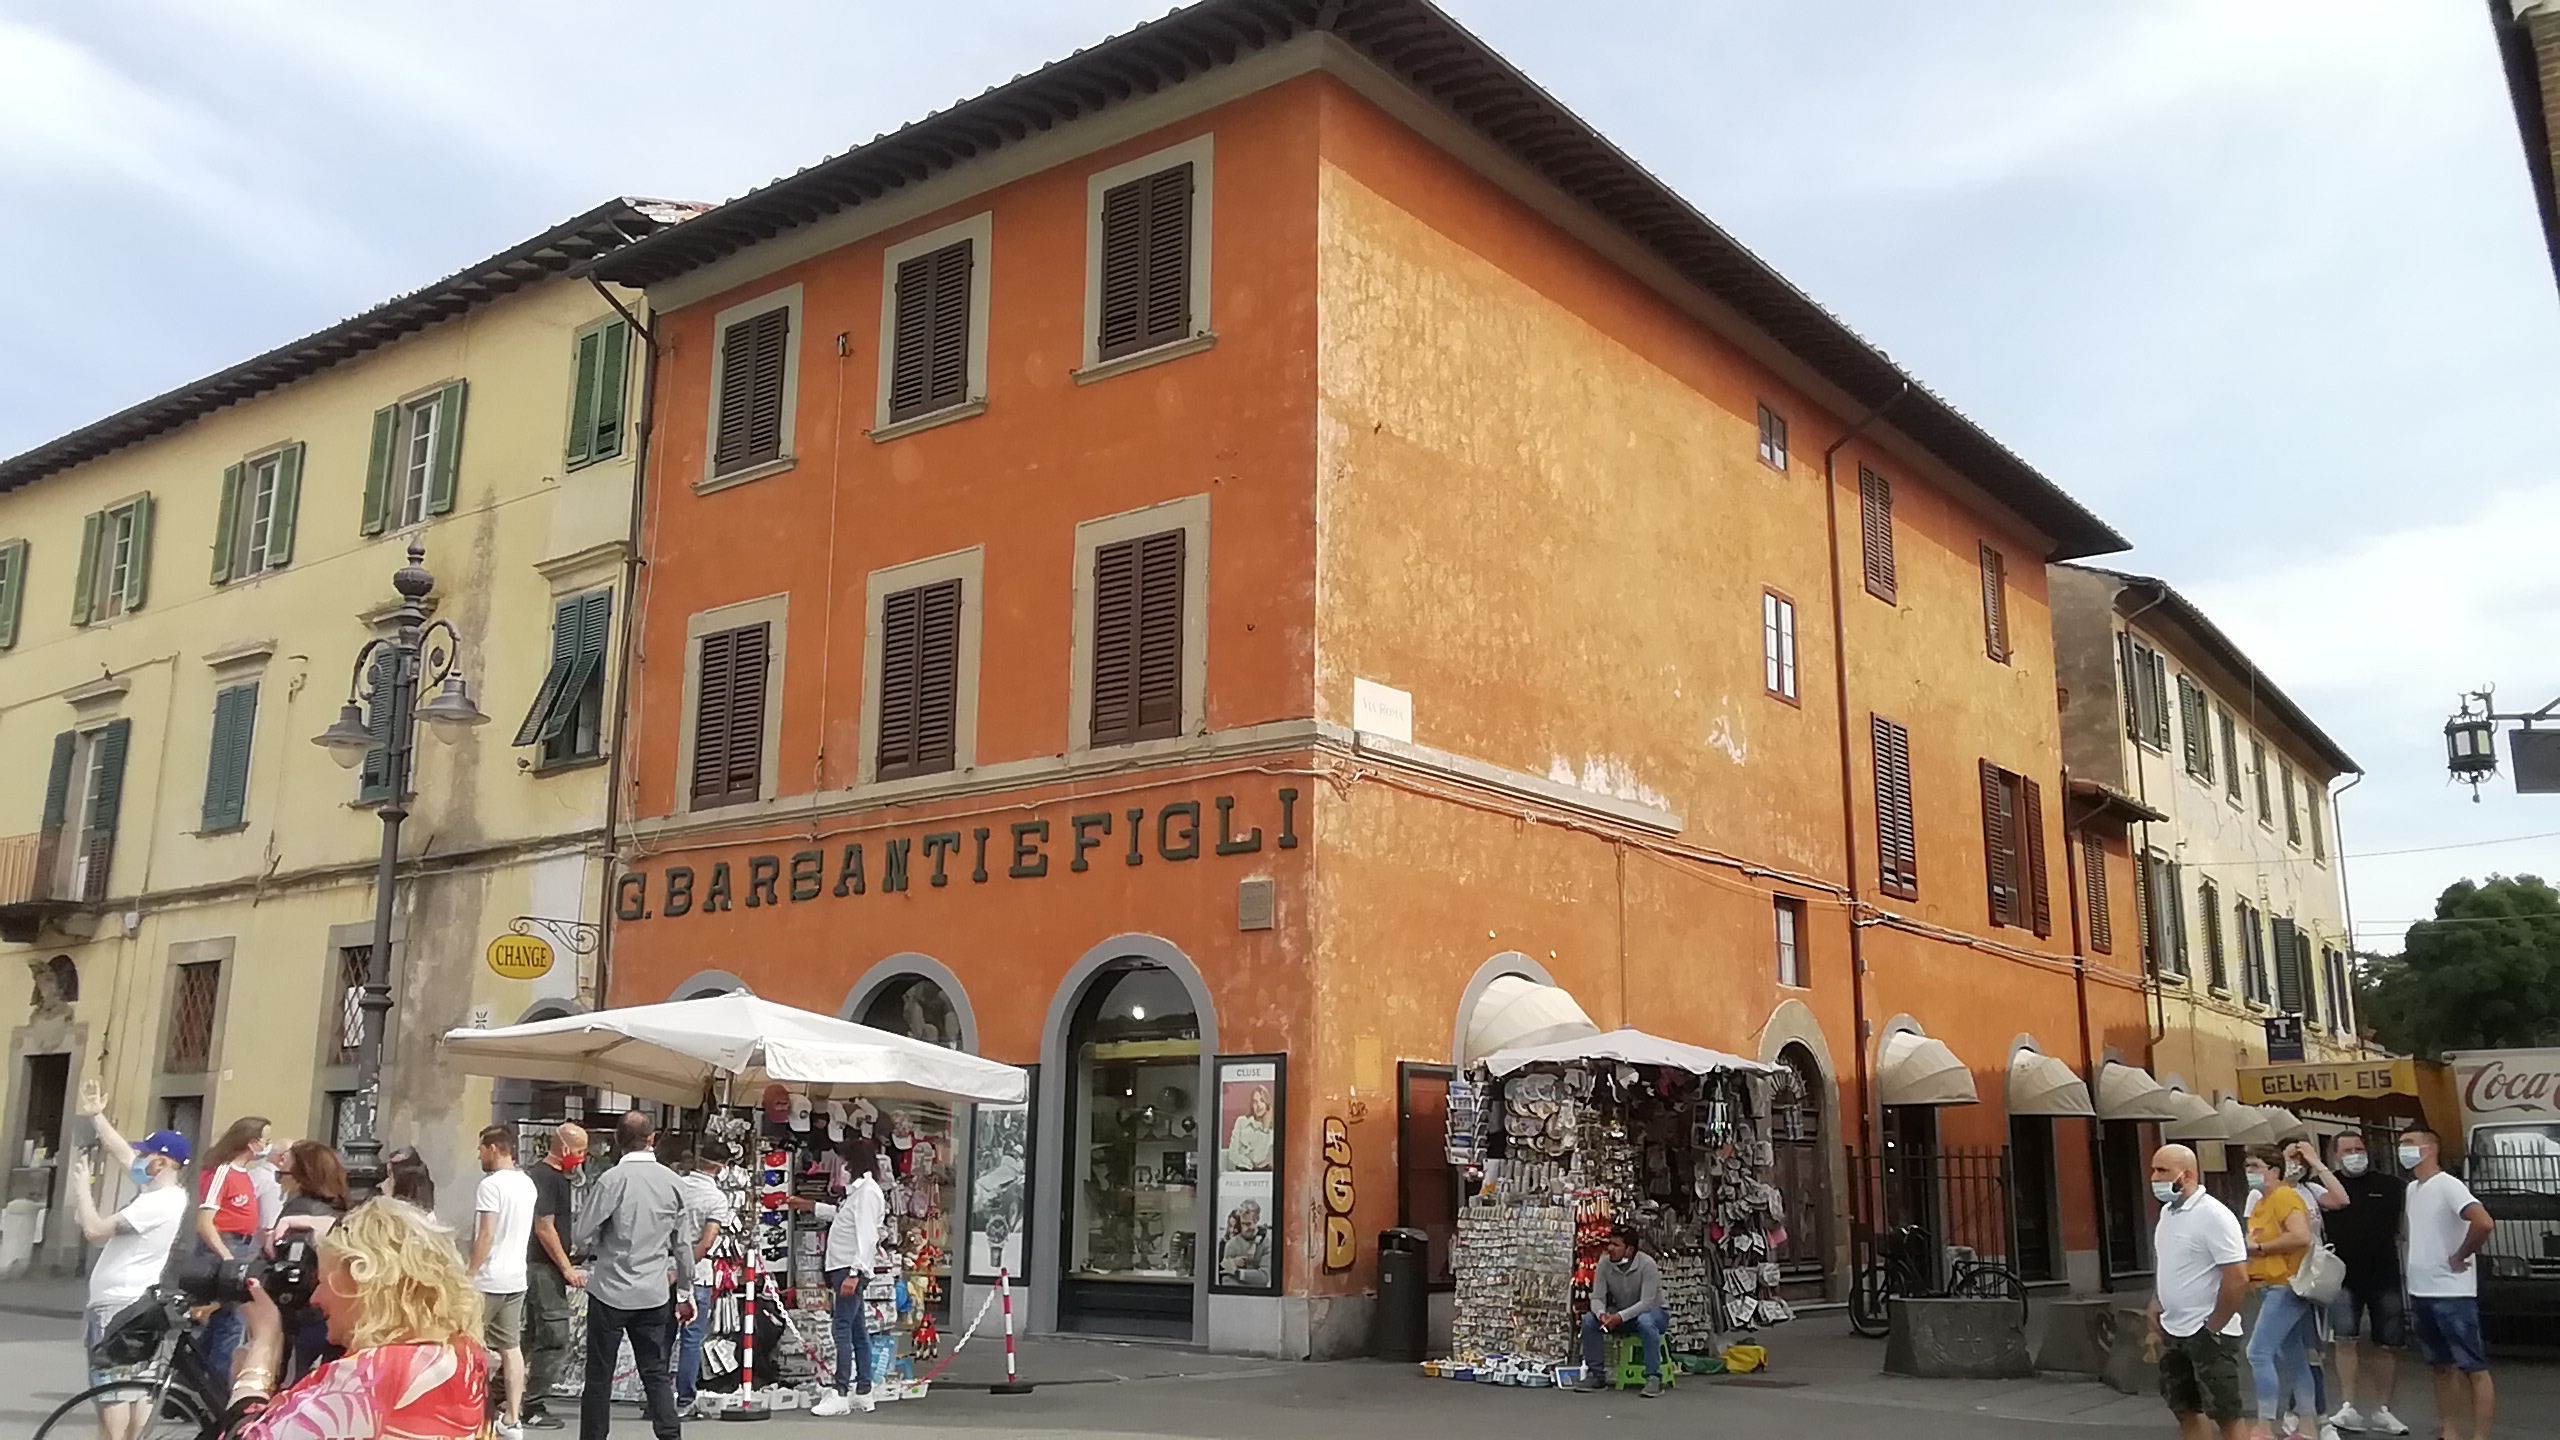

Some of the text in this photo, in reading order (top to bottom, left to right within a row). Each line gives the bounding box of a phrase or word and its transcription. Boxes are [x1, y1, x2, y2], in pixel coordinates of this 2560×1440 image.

[1362, 697, 1404, 721] VIA ROMA
[615, 788, 1299, 920] G. BARSANTI E FIGLI
[495, 944, 547, 968] CHANGE
[1236, 1068, 1261, 1077] CLUSE
[2261, 1072, 2338, 1096] GELATI
[2356, 1069, 2393, 1089] EIS
